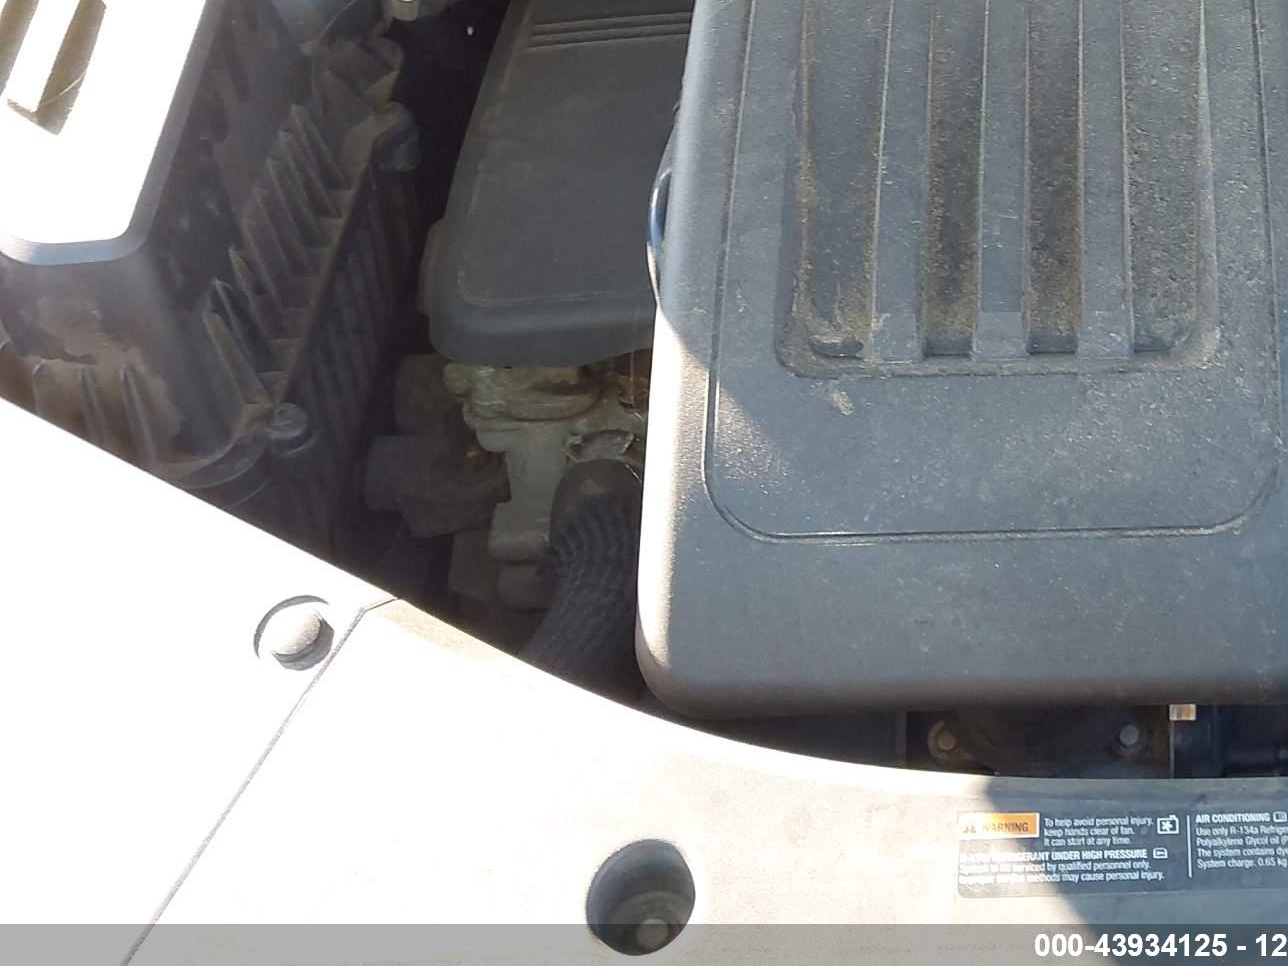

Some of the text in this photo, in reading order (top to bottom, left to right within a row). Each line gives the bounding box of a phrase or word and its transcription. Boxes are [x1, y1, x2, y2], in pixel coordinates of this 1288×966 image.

[1044, 817, 1054, 827] To
[1055, 817, 1072, 828] help
[1073, 816, 1094, 826] avoid
[1096, 816, 1129, 828] personal
[1196, 812, 1270, 824] AIR CONDITIONING
[1044, 828, 1063, 838] keep
[1064, 827, 1088, 836] hands
[1090, 827, 1108, 836] clear
[1110, 826, 1119, 835] of
[1196, 827, 1210, 836] Use
[1212, 826, 1228, 836] only
[1230, 825, 1258, 835] R-134a
[1044, 838, 1050, 846] It
[1051, 838, 1065, 846] can
[1067, 837, 1085, 846] start
[1086, 837, 1094, 845] at
[1096, 837, 1110, 848] any
[1245, 836, 1268, 846] Glycol
[1270, 836, 1280, 844] oil
[1051, 850, 1080, 860] UNDER
[1082, 850, 1102, 860] HIGH
[1104, 849, 1148, 860] PRESSURE
[1197, 848, 1212, 858] The
[1213, 848, 1240, 858] system
[1242, 847, 1274, 856] contains
[1047, 863, 1056, 874] by
[1058, 862, 1091, 873] qualified
[1093, 860, 1132, 872] personnel
[1197, 859, 1226, 870] System
[1278, 856, 1287, 868] kg
[1062, 874, 1079, 883] may
[1080, 872, 1104, 882] cause
[1106, 871, 1139, 882] personal
